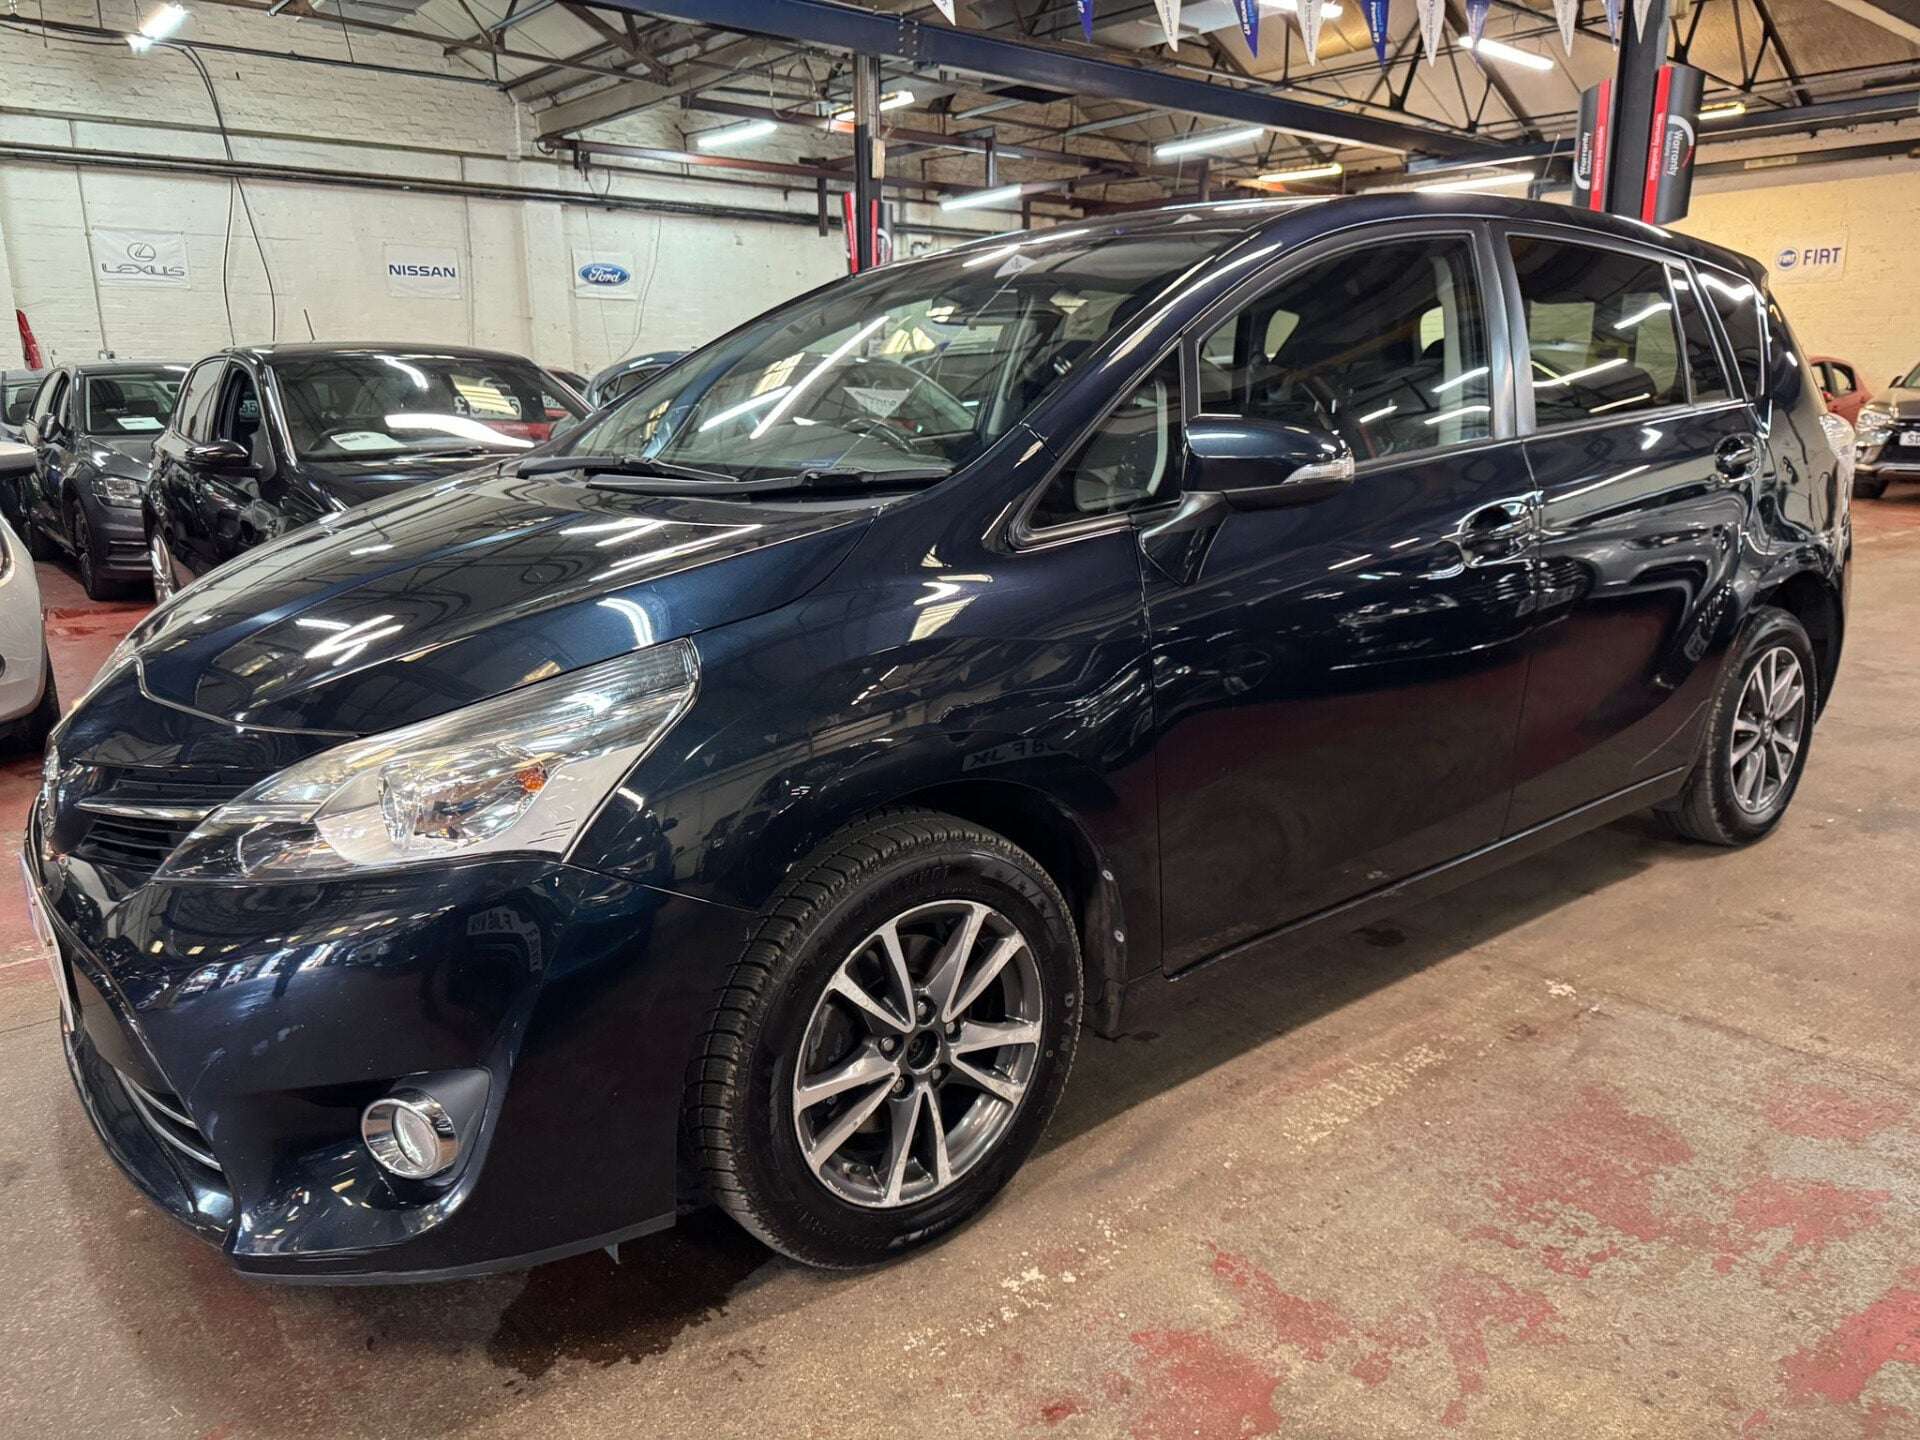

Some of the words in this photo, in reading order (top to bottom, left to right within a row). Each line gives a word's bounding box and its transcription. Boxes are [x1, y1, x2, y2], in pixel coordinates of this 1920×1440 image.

[1579, 132, 1592, 176] Warranty
[1667, 130, 1684, 176] Warranty
[1803, 247, 1842, 265] FIAT
[102, 263, 185, 276] LEXUS
[388, 264, 456, 278] NISSAN
[588, 267, 621, 284] Ford
